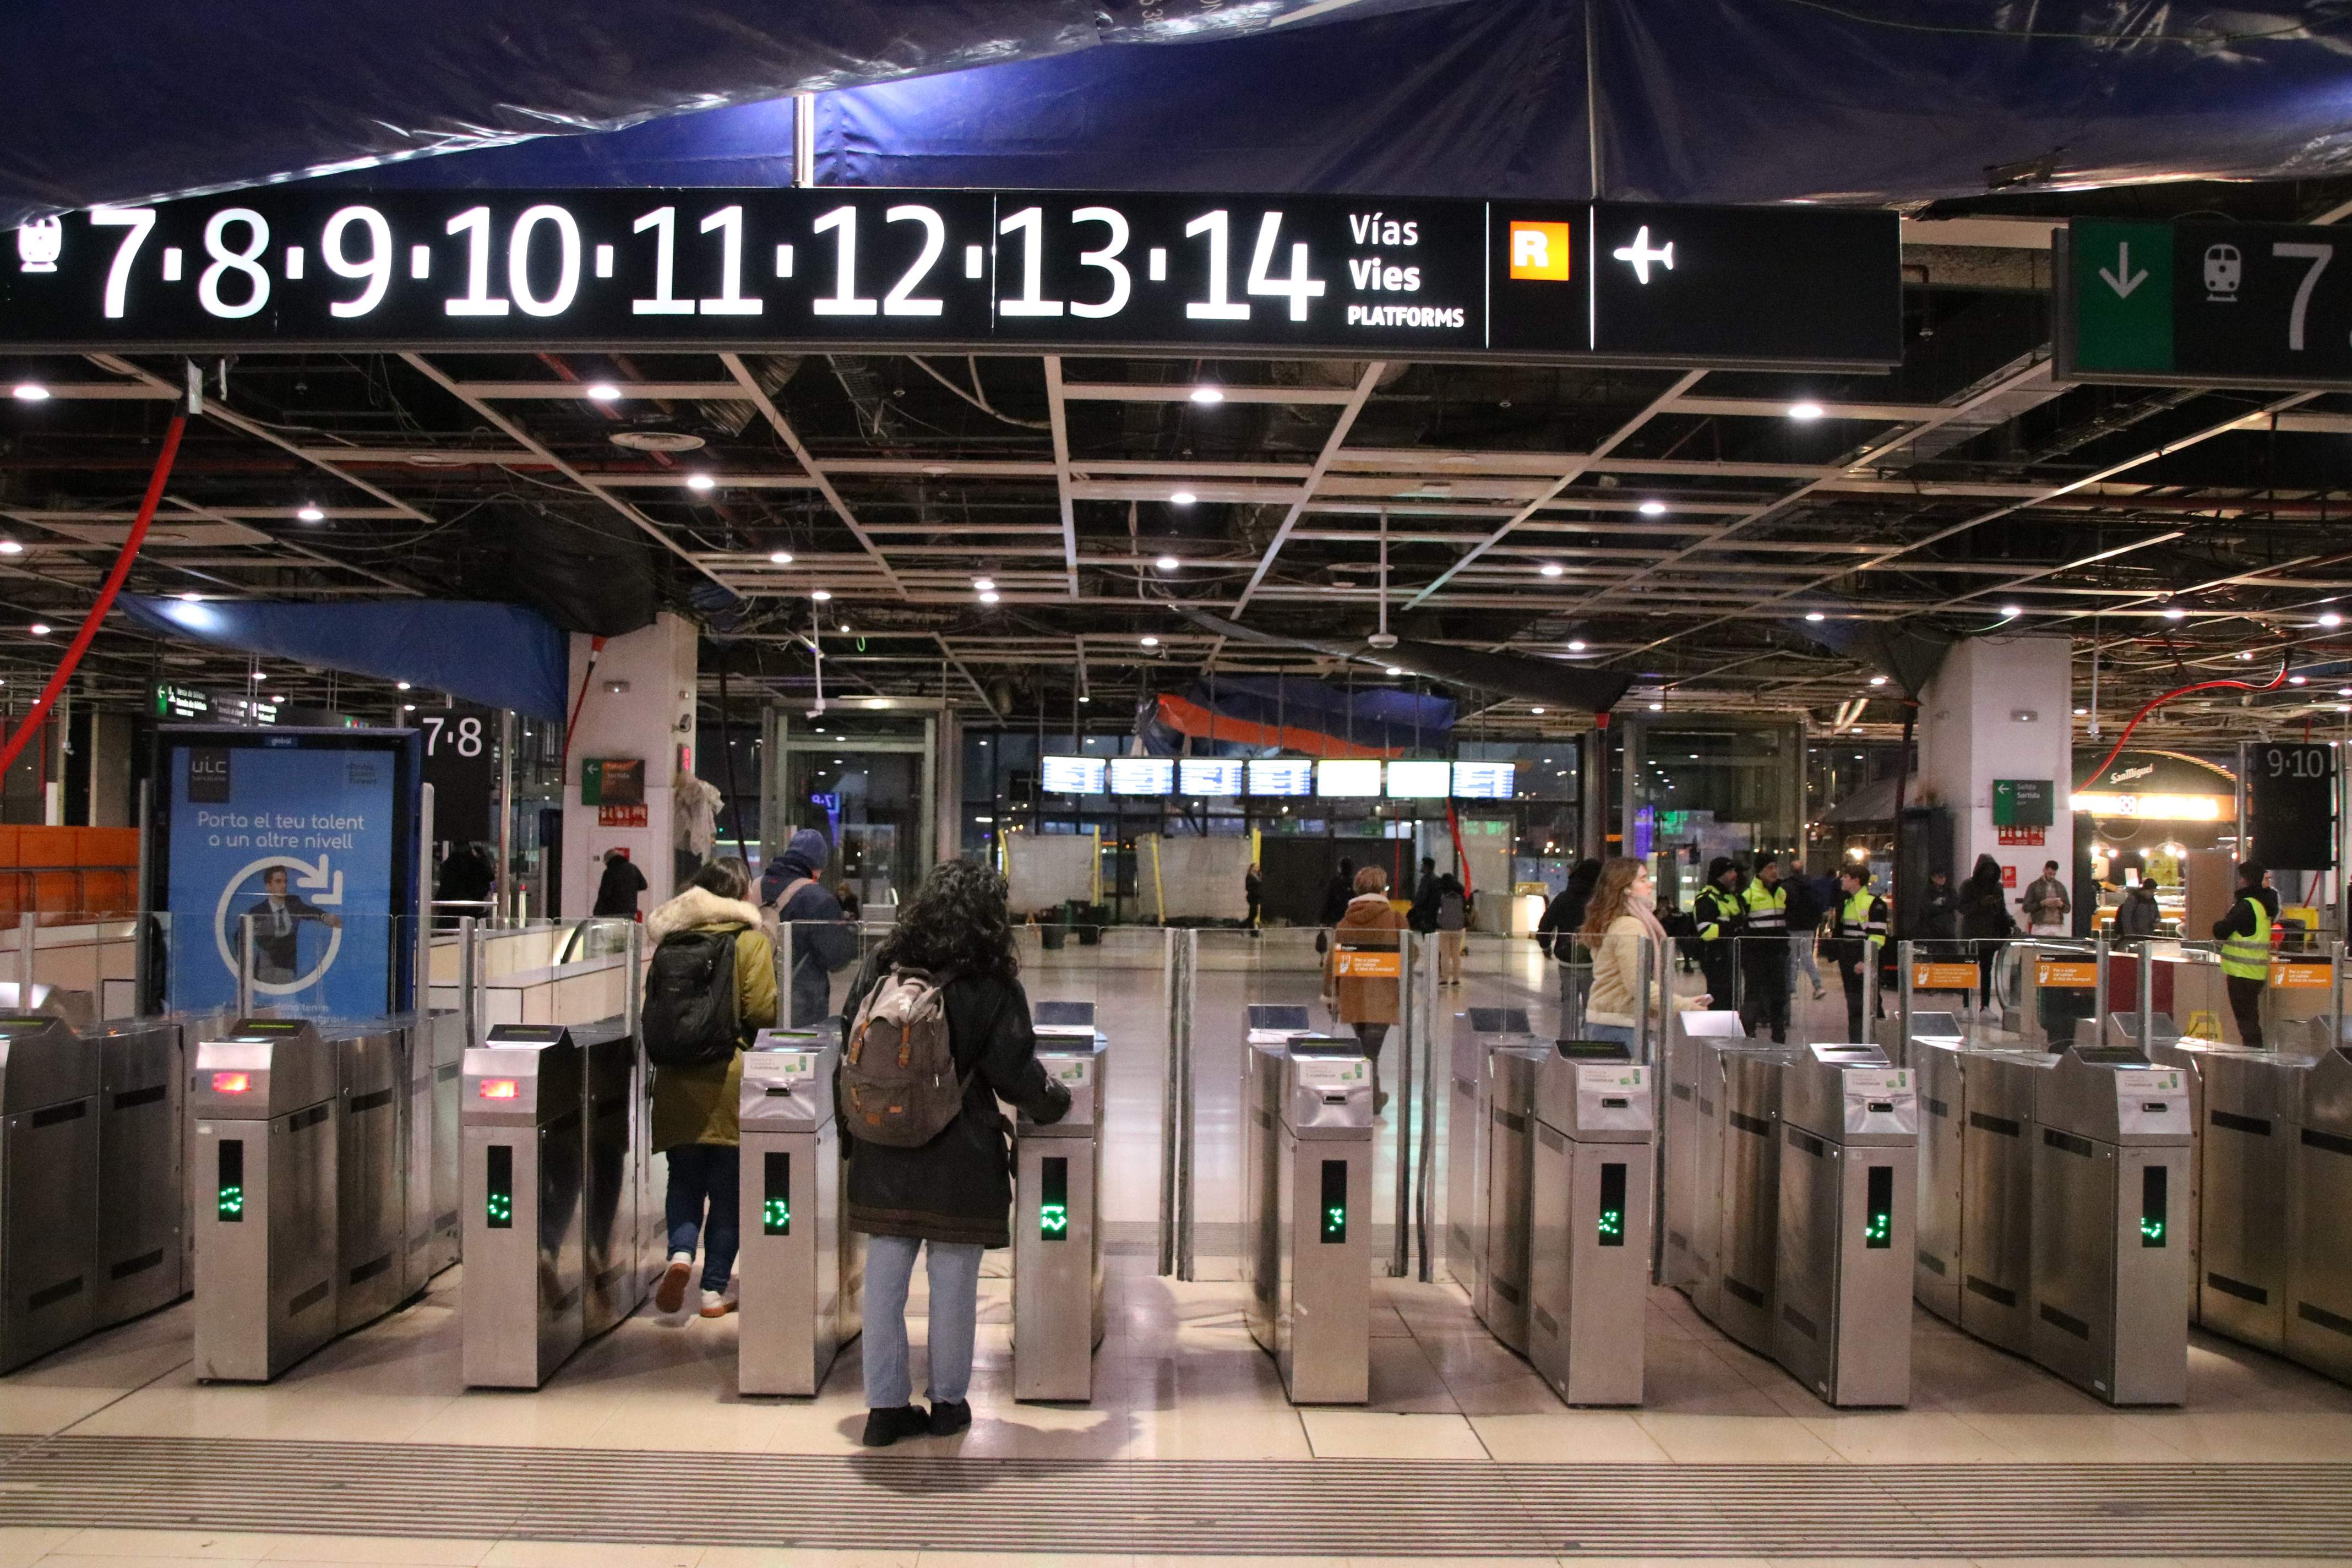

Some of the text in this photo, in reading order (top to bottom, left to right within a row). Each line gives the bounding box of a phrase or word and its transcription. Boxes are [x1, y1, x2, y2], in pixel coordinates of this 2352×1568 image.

[1349, 213, 1418, 246] Vías
[1514, 230, 1548, 267] R
[1349, 258, 1420, 292] Vies
[2272, 243, 2333, 351] 7
[1348, 306, 1464, 328] PLATFORMS
[198, 810, 364, 830] Porta el teu talent
[209, 832, 353, 850] a un altre nivell
